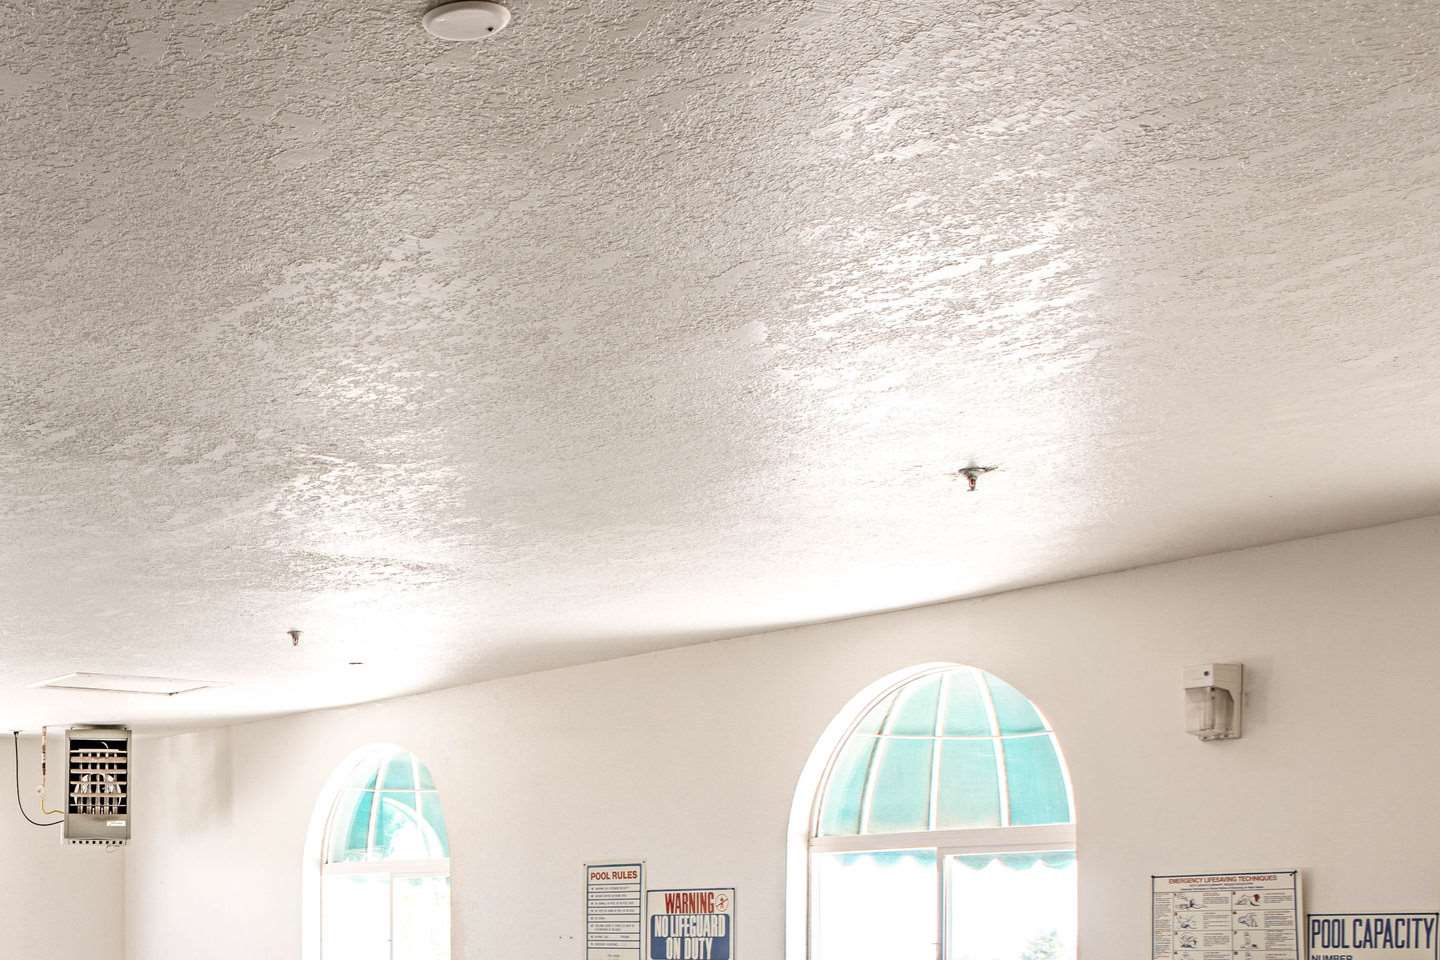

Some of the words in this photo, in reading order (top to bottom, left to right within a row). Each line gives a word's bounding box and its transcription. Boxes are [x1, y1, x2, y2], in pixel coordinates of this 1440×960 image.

[591, 872, 610, 880] POOL
[612, 871, 638, 880] RULES
[664, 892, 714, 914] WARNING
[654, 916, 668, 937] NO
[670, 915, 725, 937] LIFEGUARD
[1312, 919, 1349, 948] POOL
[1353, 918, 1434, 948] CAPACITY
[666, 938, 680, 960] ON
[685, 937, 713, 960] DUTY
